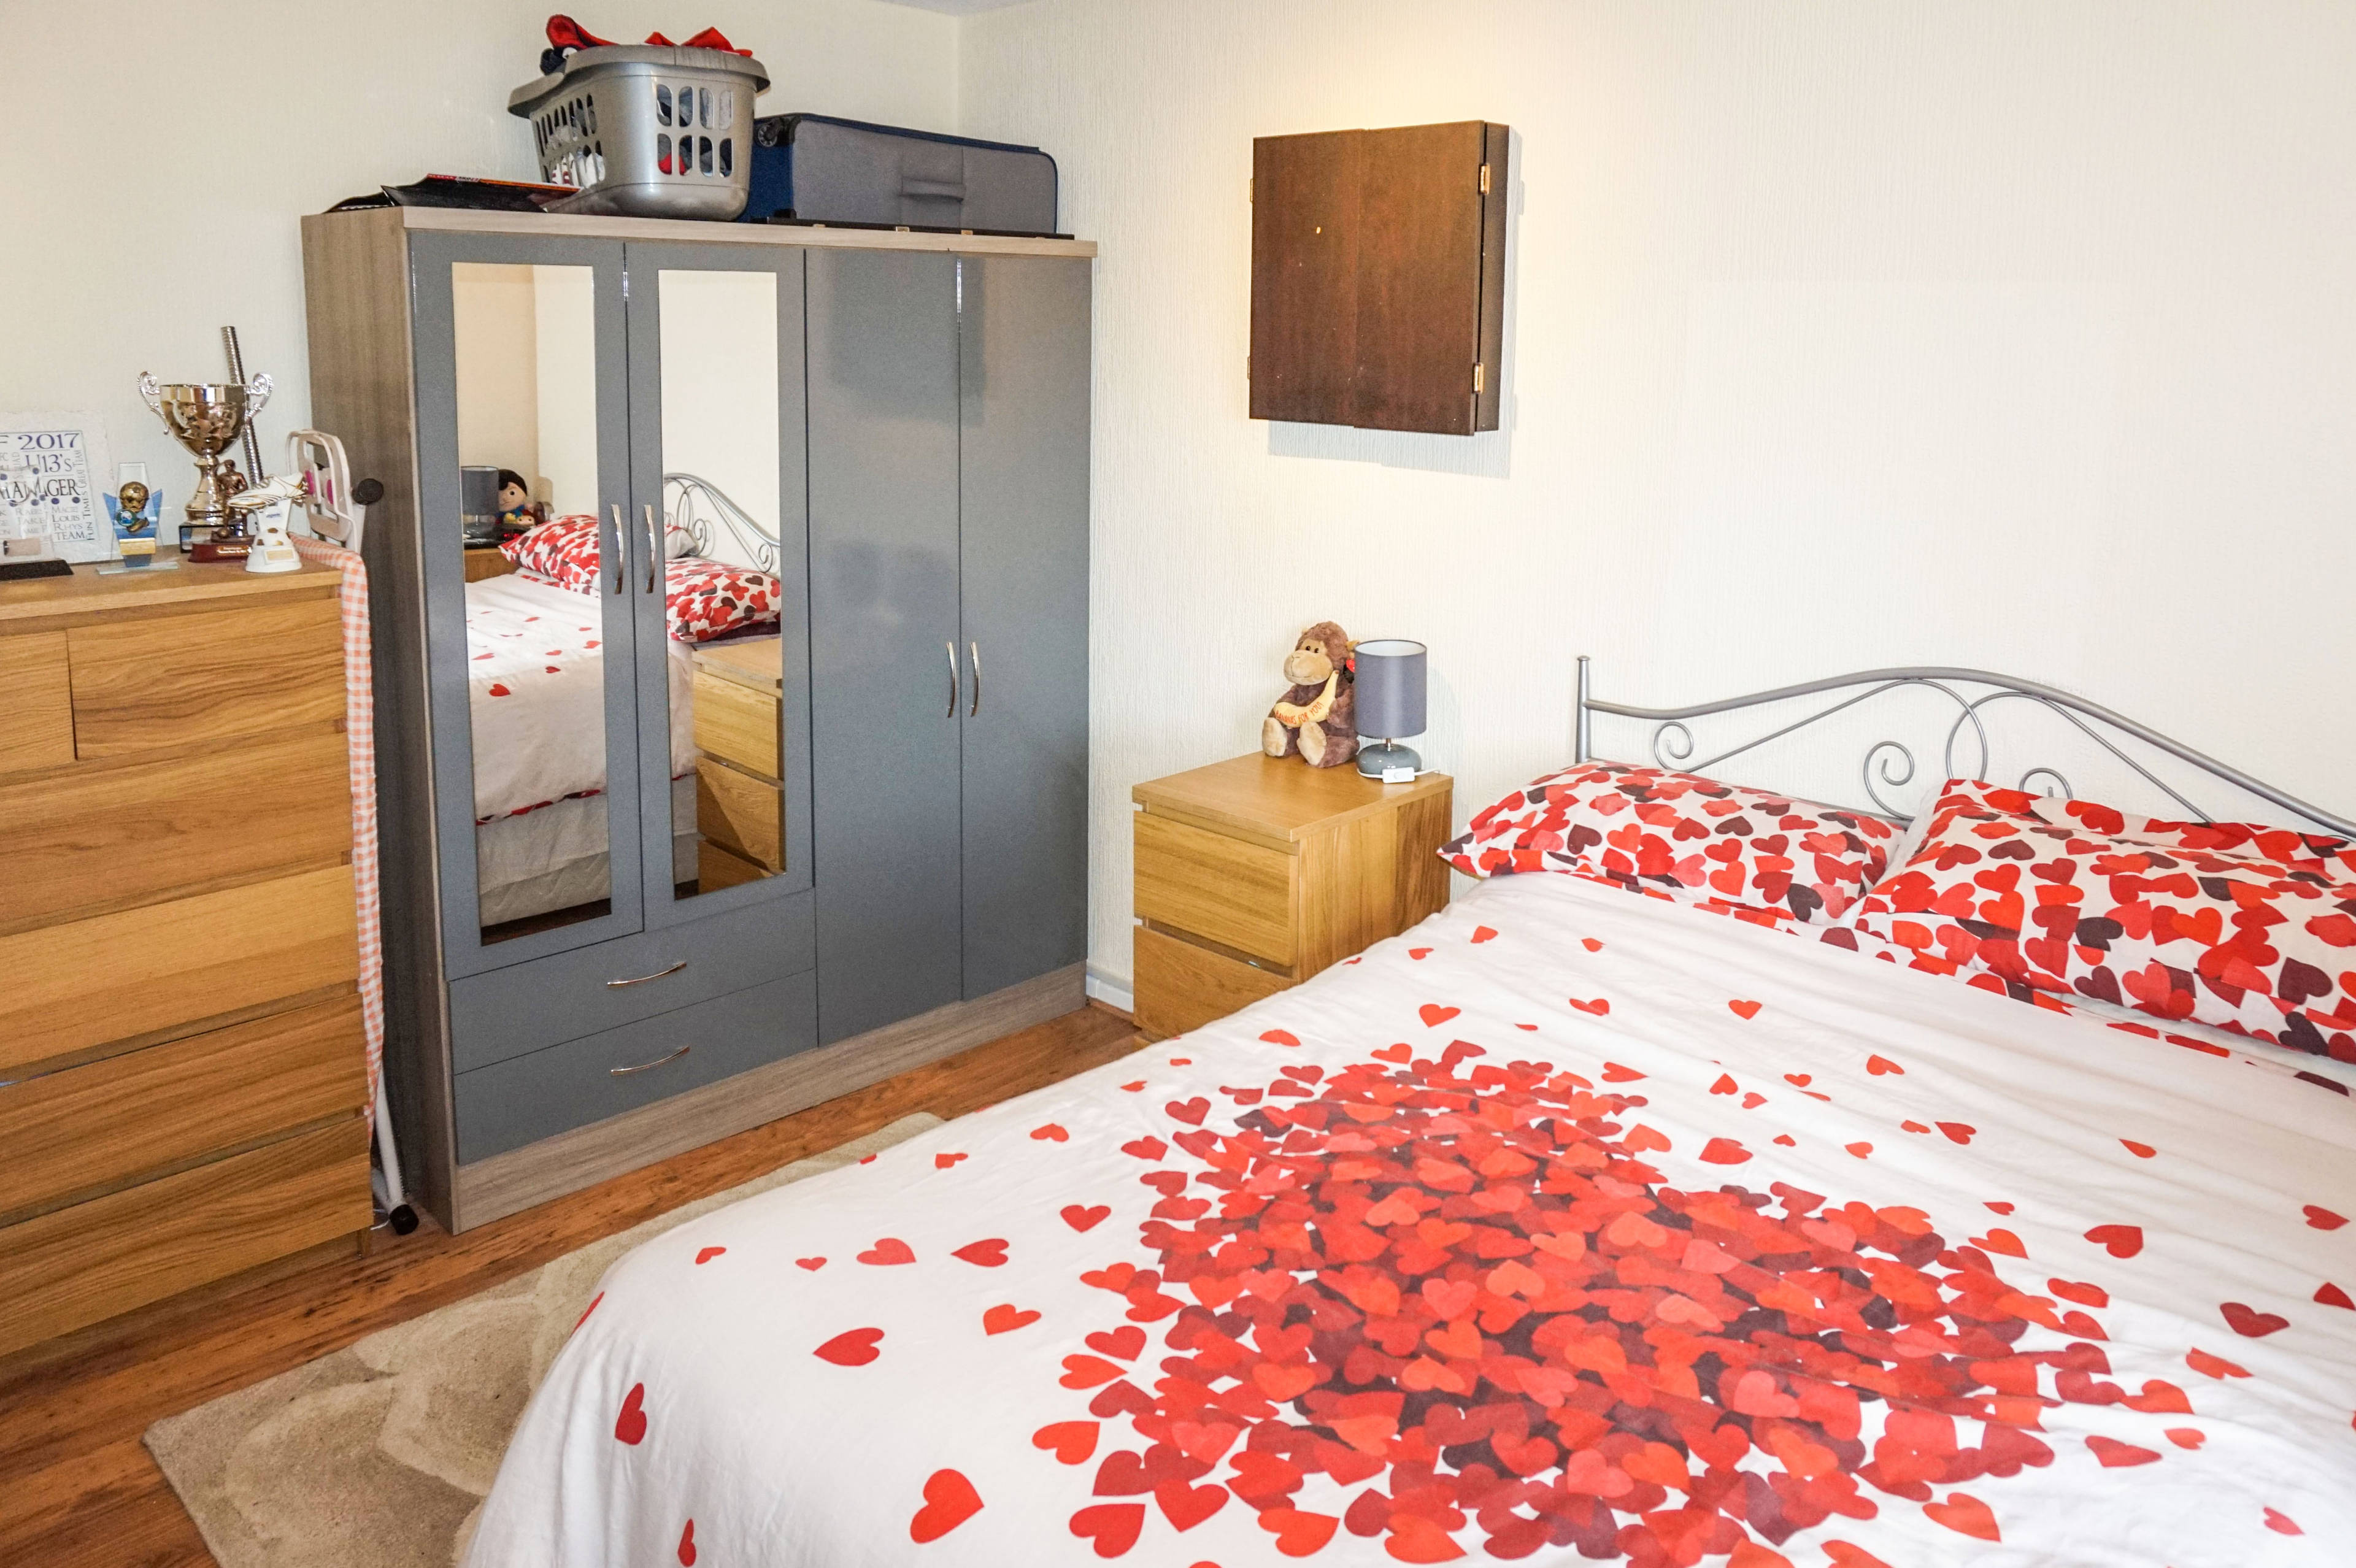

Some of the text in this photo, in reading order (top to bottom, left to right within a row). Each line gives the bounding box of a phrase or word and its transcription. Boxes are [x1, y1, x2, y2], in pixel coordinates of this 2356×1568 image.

[18, 432, 80, 450] 2017
[54, 531, 85, 540] TEAM
[1298, 712, 1309, 723] FOR
